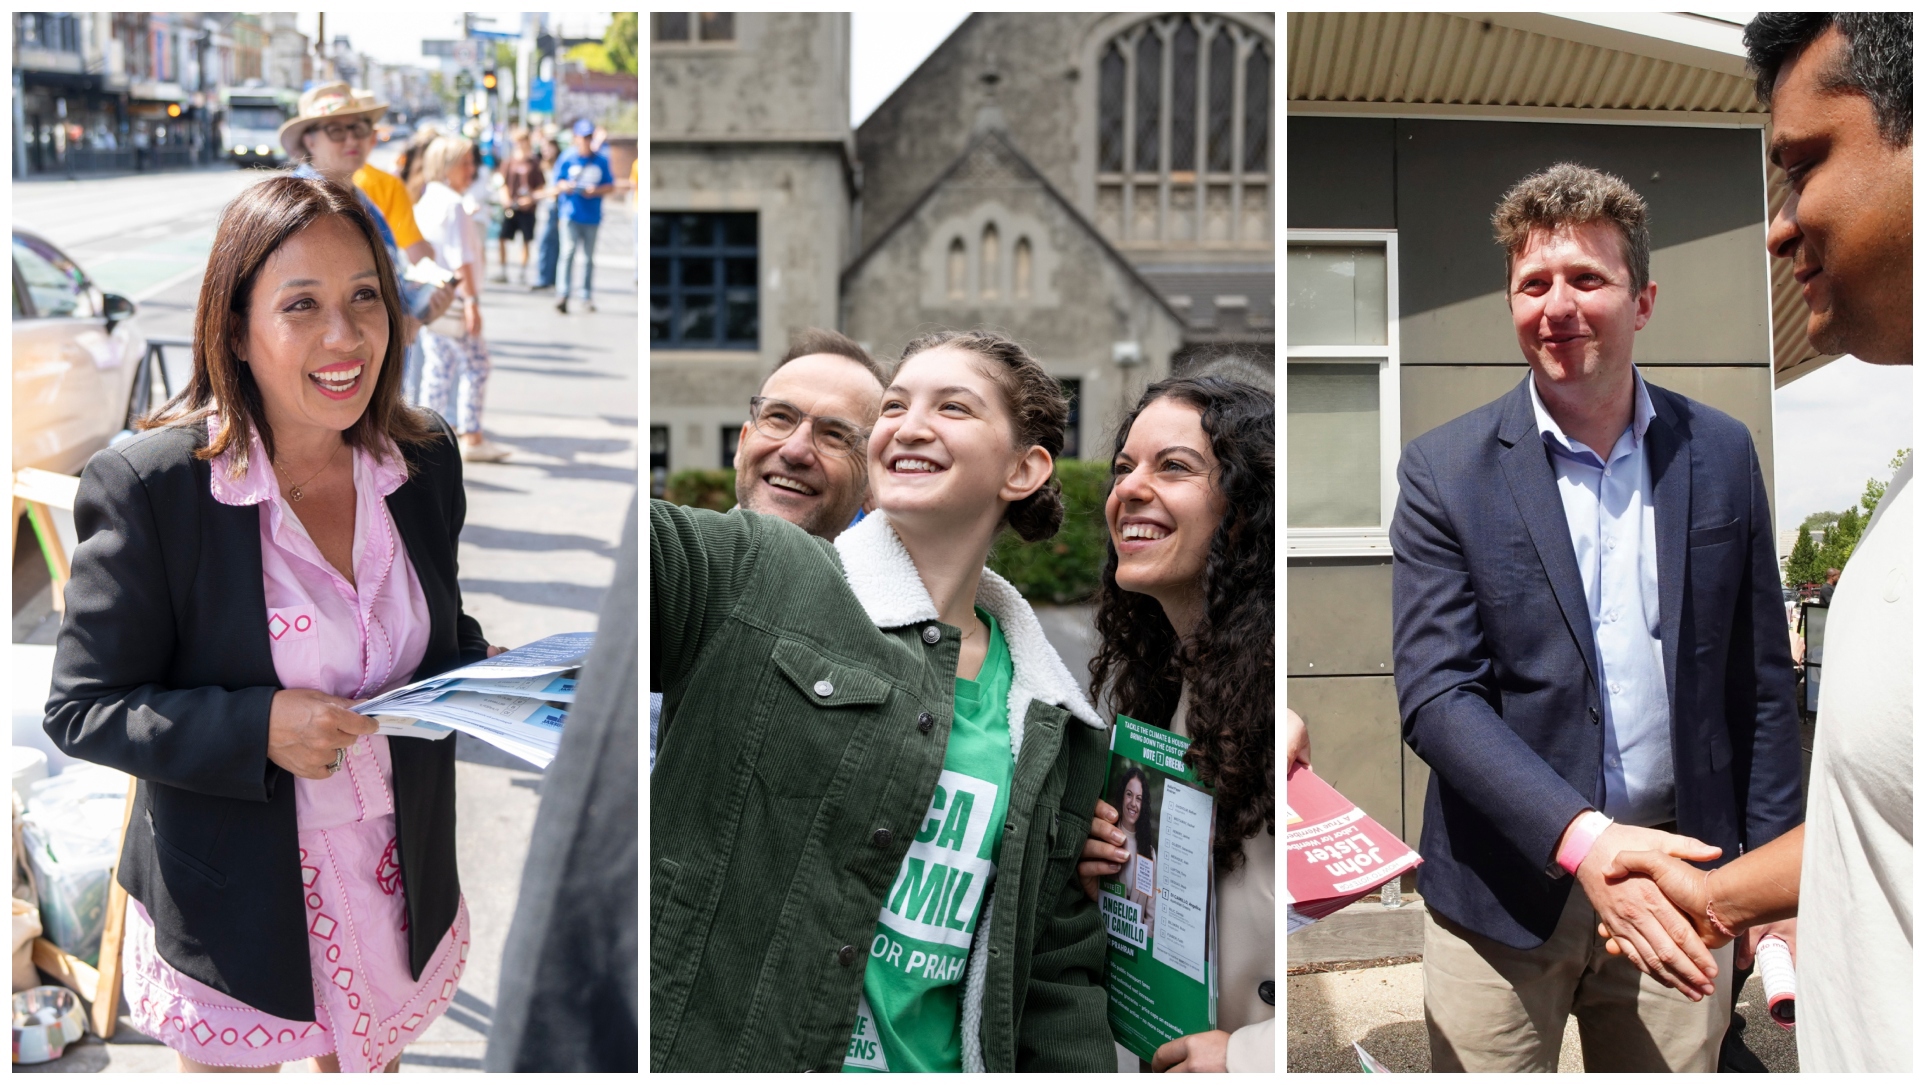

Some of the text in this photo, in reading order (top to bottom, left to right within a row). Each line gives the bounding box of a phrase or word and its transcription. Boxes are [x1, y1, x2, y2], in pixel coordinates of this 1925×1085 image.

[1125, 720, 1140, 732] TACKLE
[1140, 726, 1149, 735] THE
[1149, 729, 1167, 742] CLIMATE
[1130, 731, 1143, 742] BRING
[1143, 736, 1156, 747] DOWN
[1156, 741, 1165, 750] THE
[1165, 745, 1177, 754] COST
[1143, 747, 1155, 761] VOTE
[1165, 756, 1185, 772] GREENS
[1322, 819, 1344, 830] True
[1334, 825, 1359, 839] Labor
[1303, 832, 1376, 864] Lister
[1320, 835, 1334, 843] for
[1325, 846, 1385, 877] John
[1339, 862, 1399, 891] HOW TO VOTE FOR
[1102, 896, 1138, 925] ANGELICA
[1111, 916, 1144, 944] CAMILLO
[1111, 940, 1134, 957] PRAHRAN
